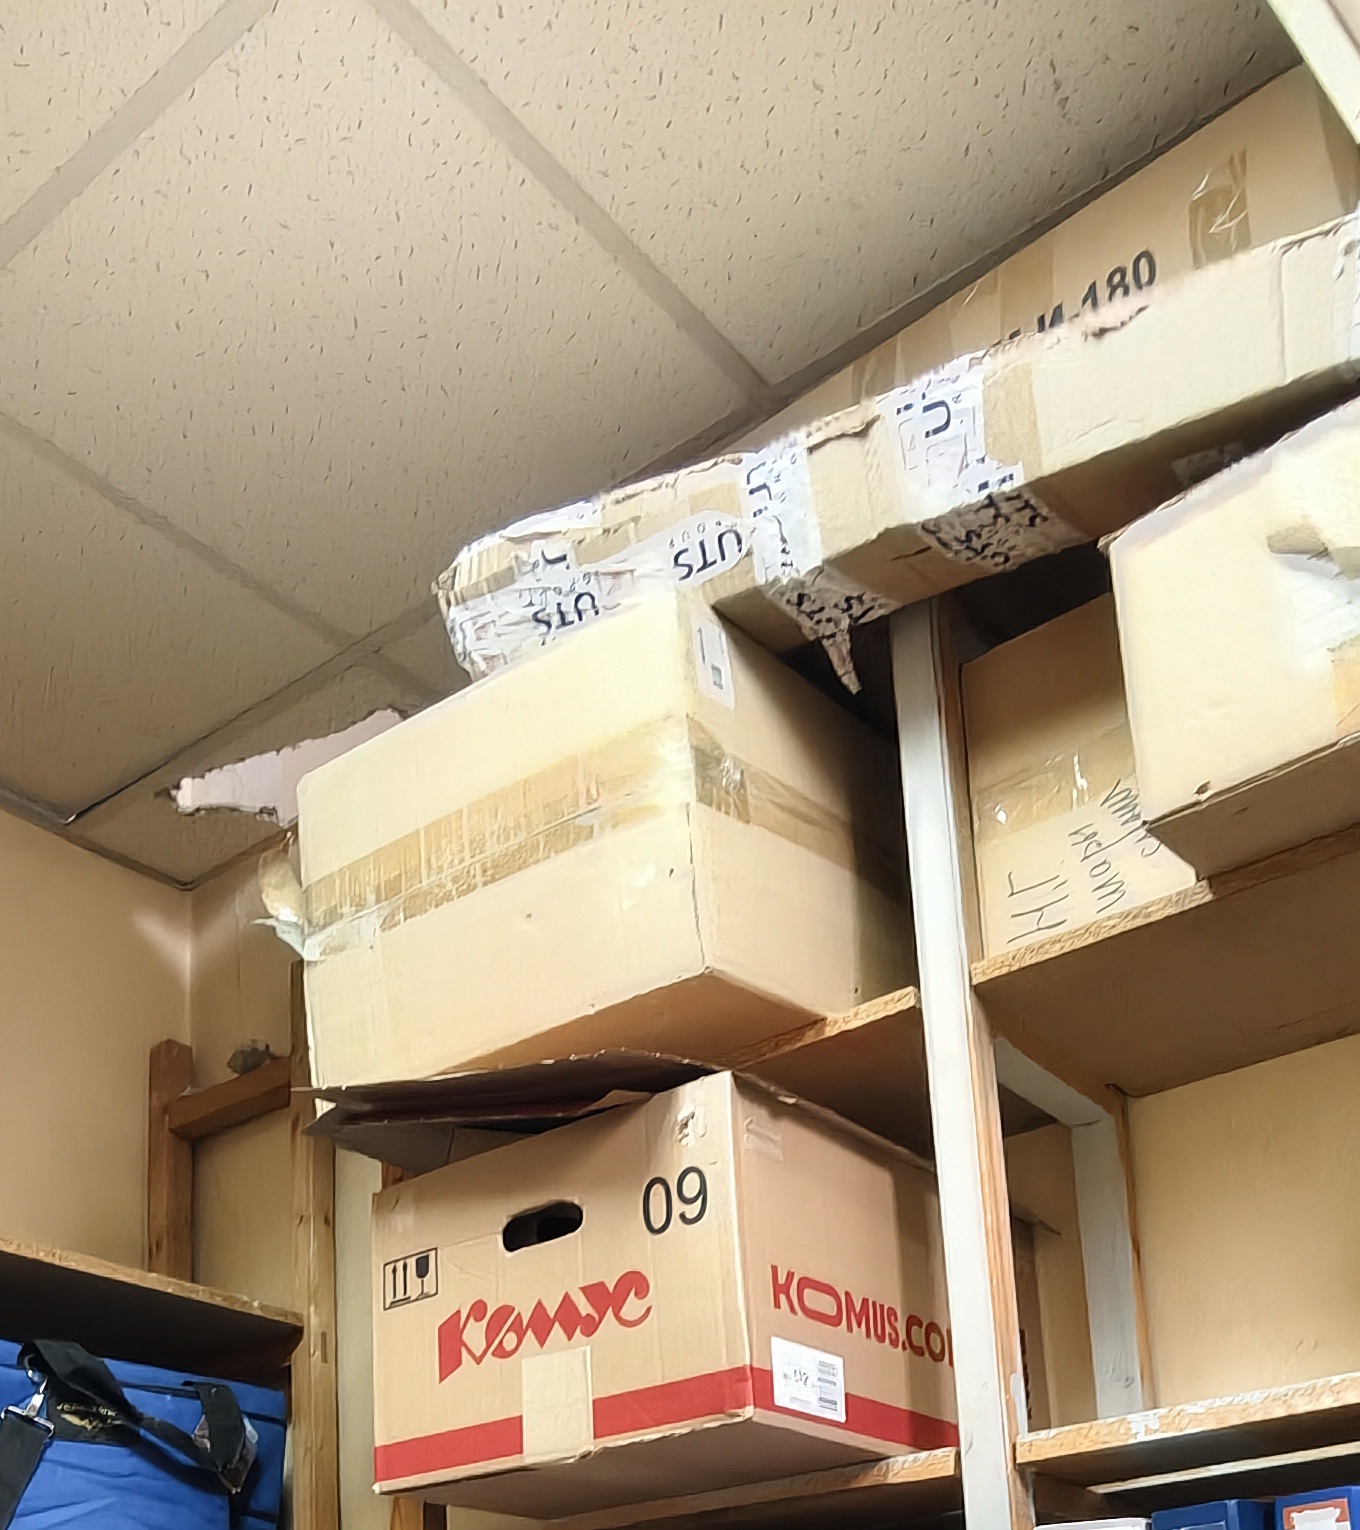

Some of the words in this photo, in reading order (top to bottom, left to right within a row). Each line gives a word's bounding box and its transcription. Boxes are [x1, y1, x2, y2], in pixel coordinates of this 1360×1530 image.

[673, 528, 743, 581] UTS
[532, 591, 599, 637] UTS
[642, 1165, 710, 1236] 09
[770, 1264, 955, 1369] KOMUS.CO
